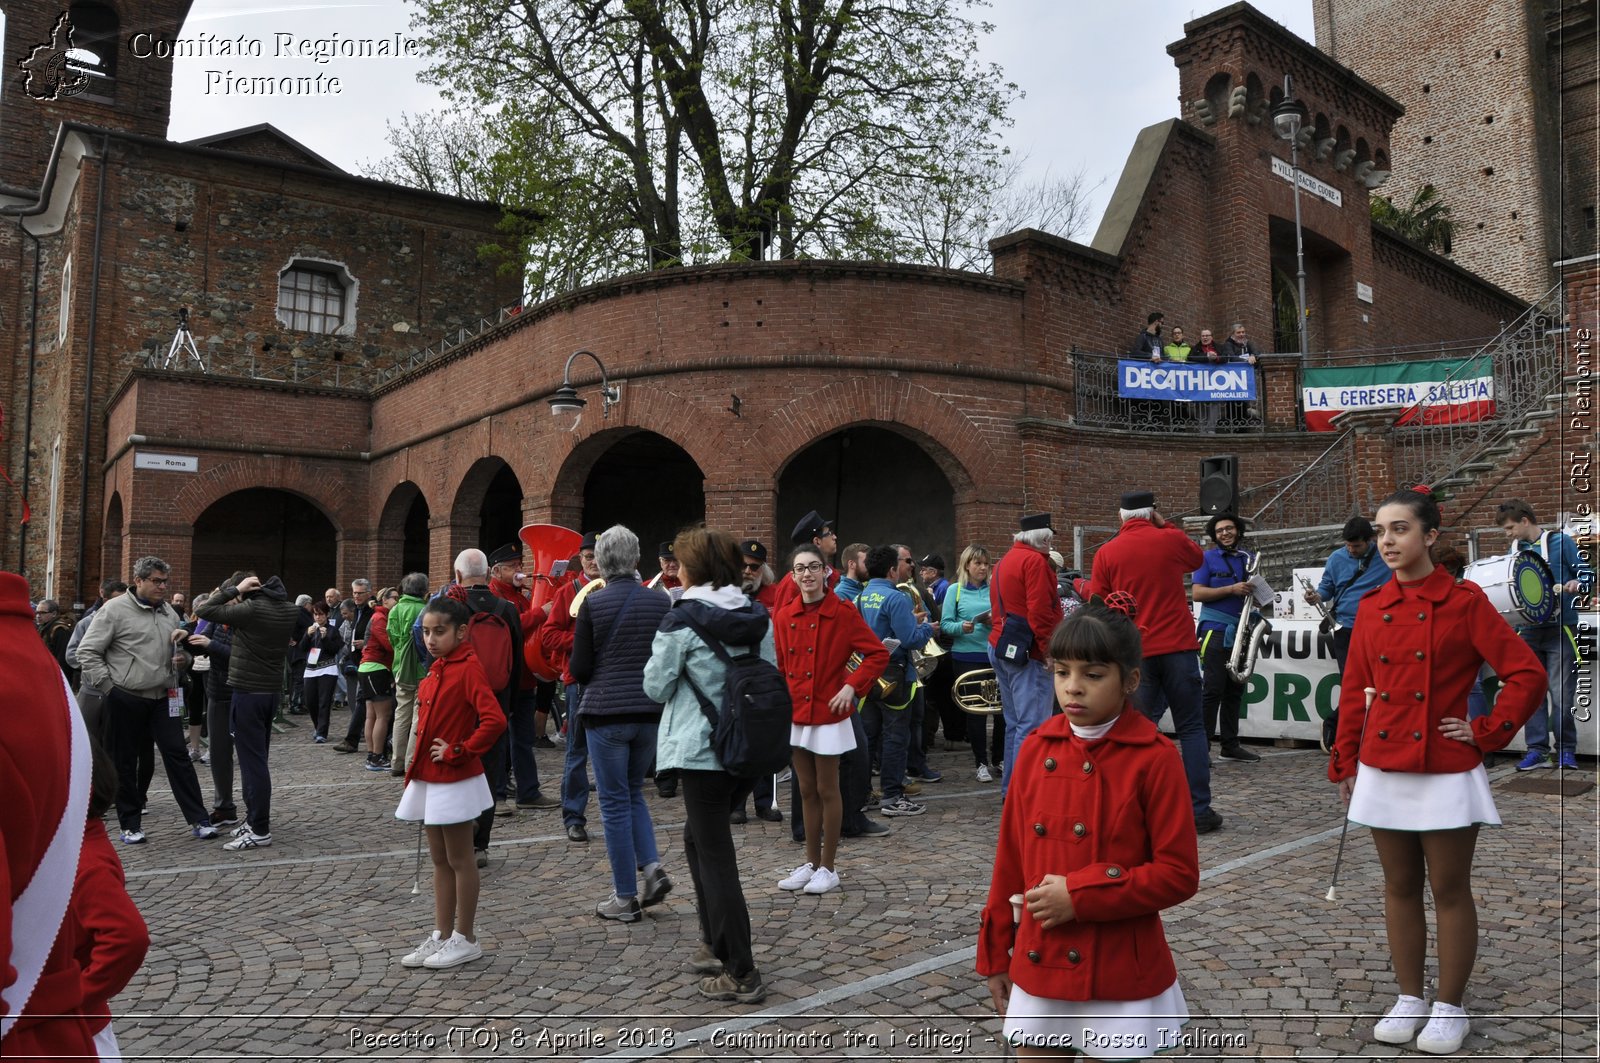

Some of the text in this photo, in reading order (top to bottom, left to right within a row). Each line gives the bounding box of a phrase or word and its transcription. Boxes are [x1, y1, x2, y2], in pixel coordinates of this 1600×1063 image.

[1299, 175, 1317, 190] SACRO
[1318, 185, 1336, 200] CUORE
[1125, 367, 1248, 391] DECATHLON
[1428, 383, 1488, 402] SALUTA
